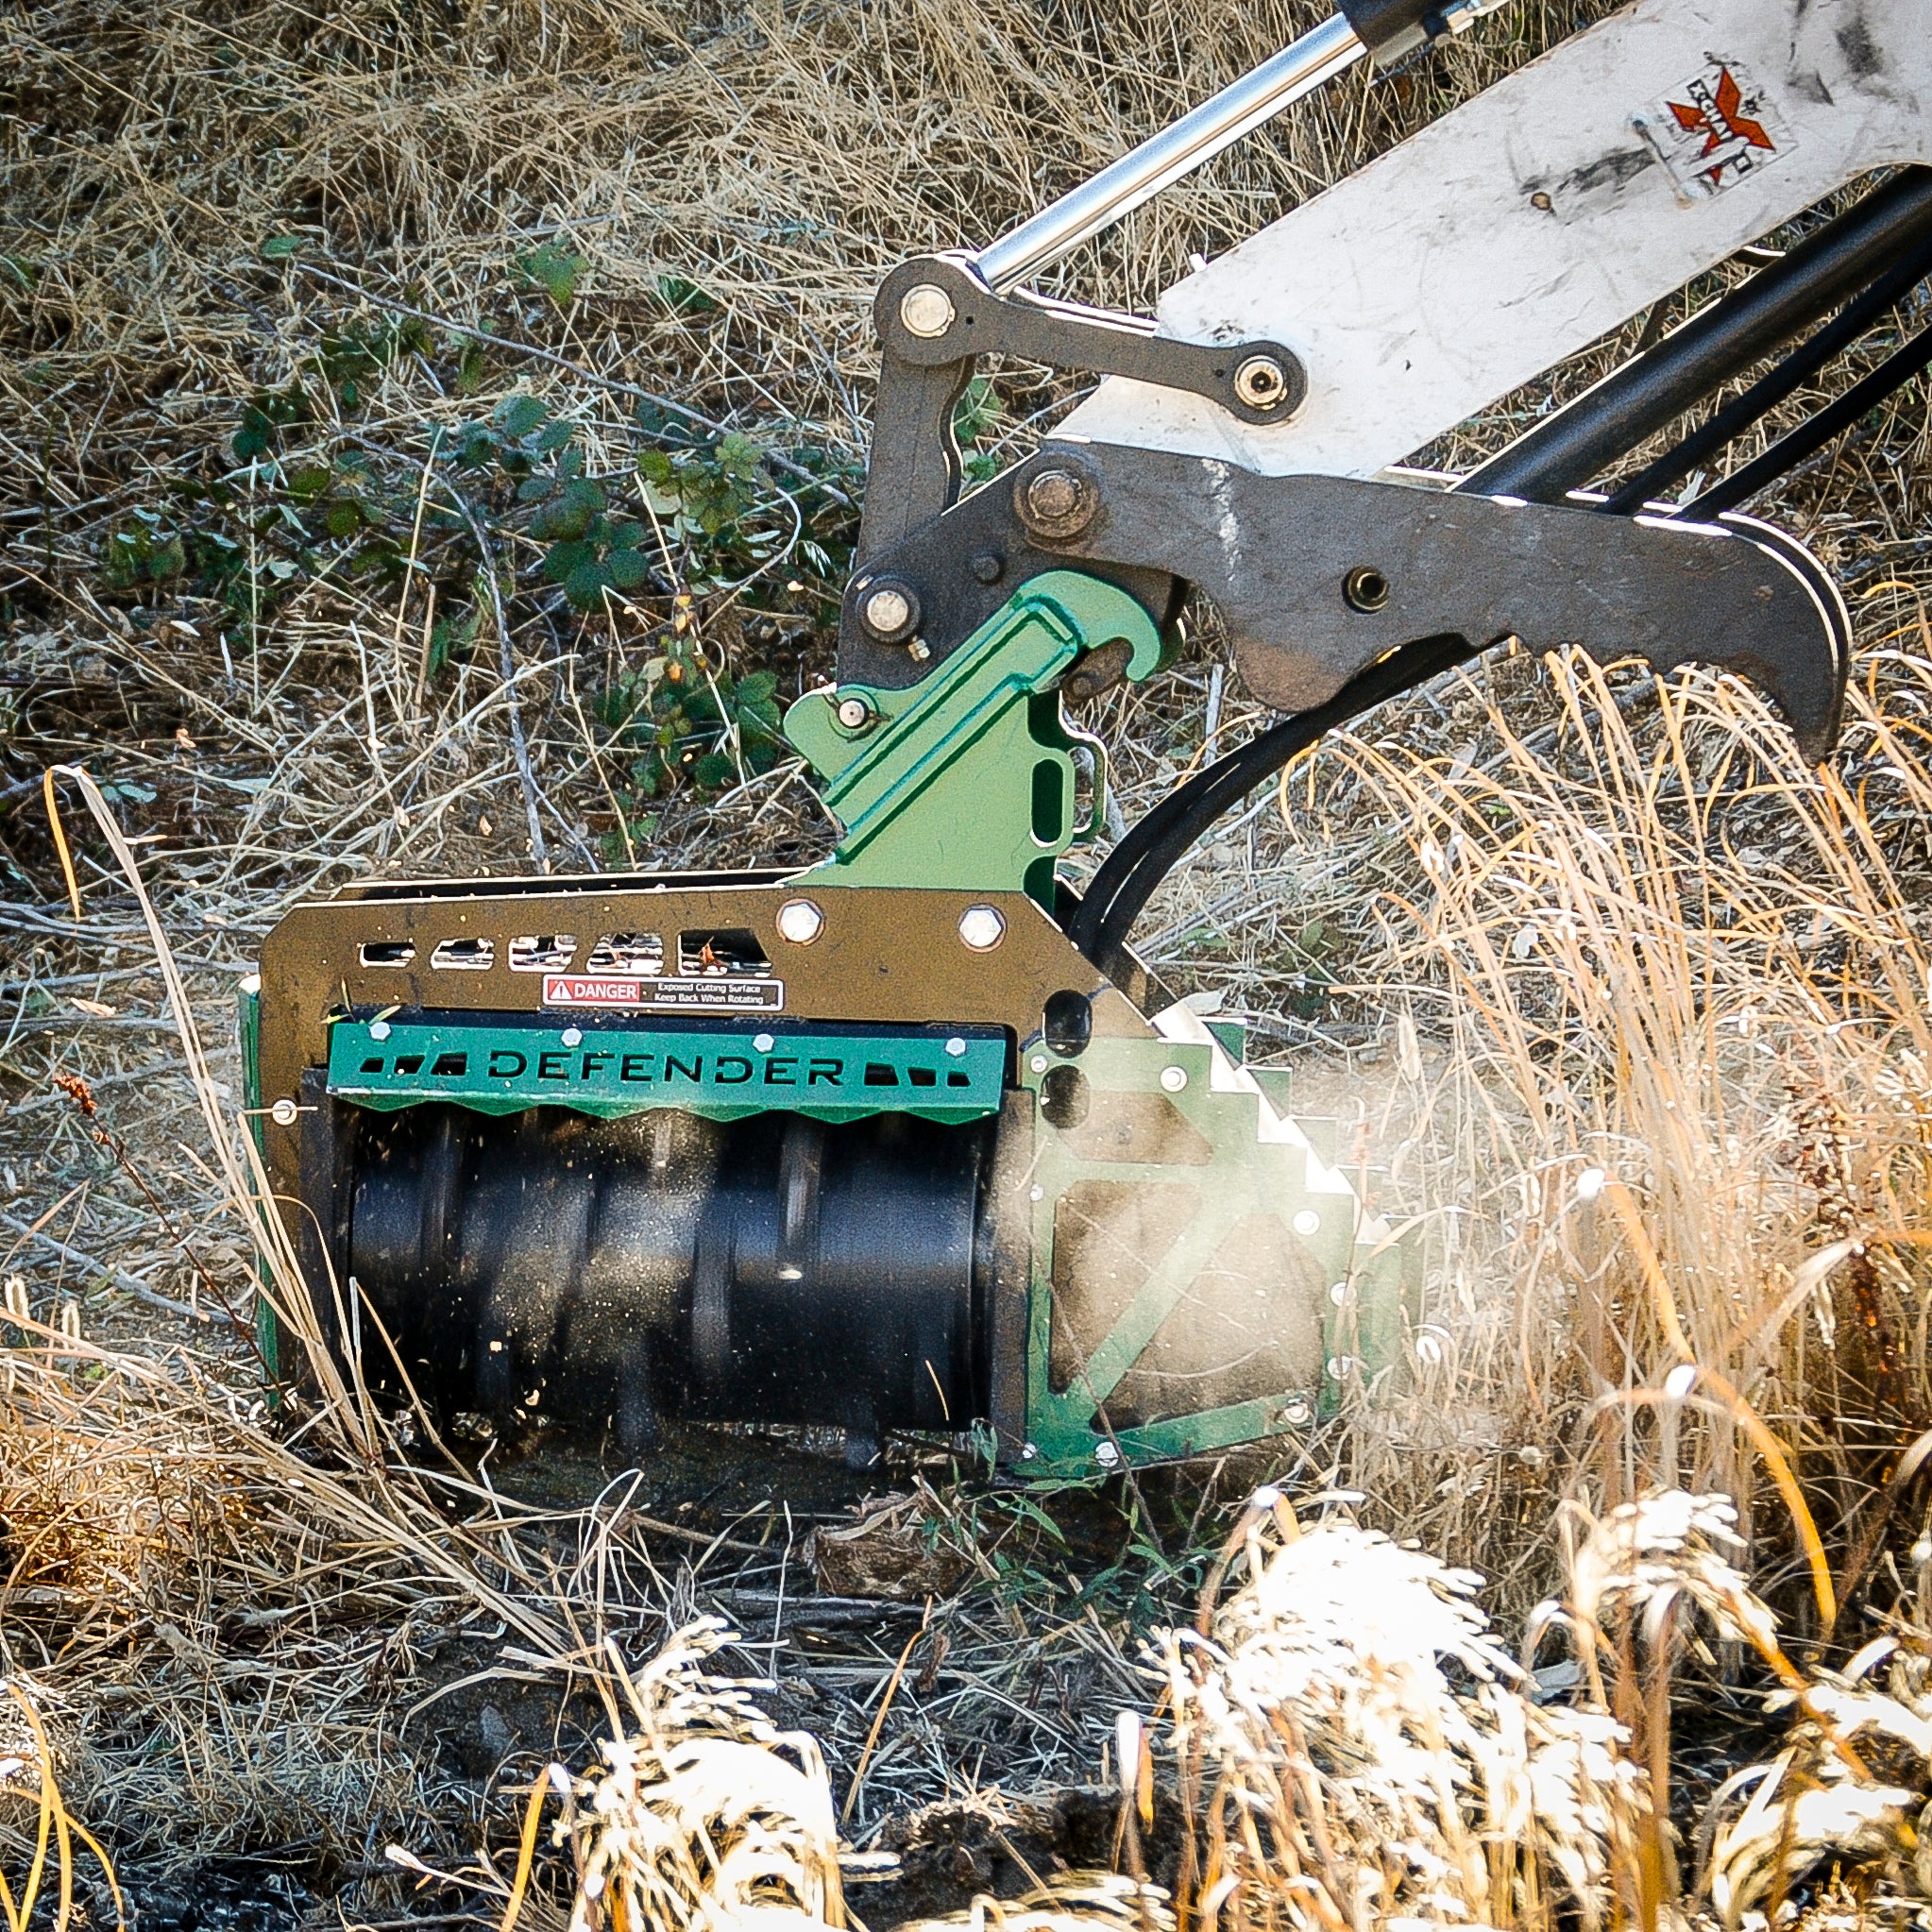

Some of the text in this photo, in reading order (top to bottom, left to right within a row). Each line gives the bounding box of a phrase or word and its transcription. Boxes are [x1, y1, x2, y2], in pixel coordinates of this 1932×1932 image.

[574, 982, 637, 1000] DANGER
[657, 982, 761, 993] Exposed Cutting Surface
[654, 992, 764, 1005] Keep Back When Rotating
[487, 1049, 844, 1086] DEFENDER
